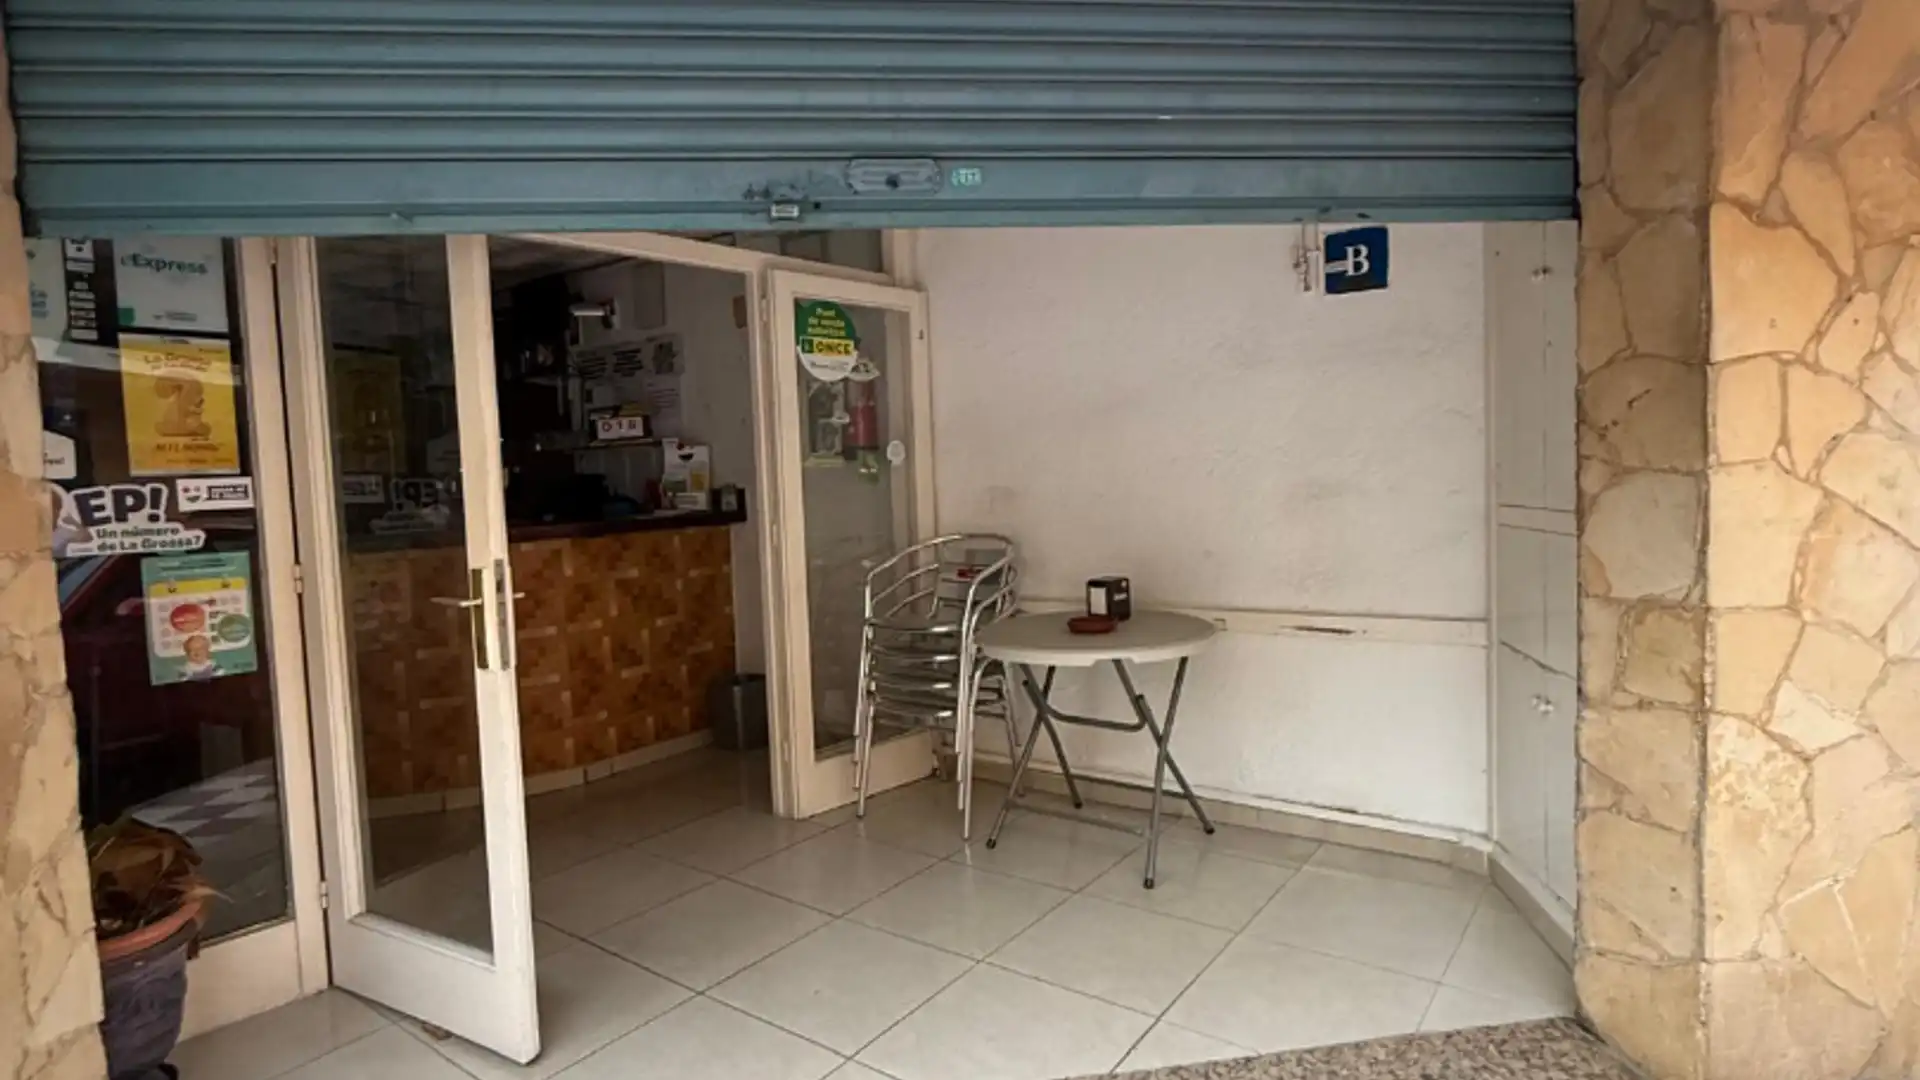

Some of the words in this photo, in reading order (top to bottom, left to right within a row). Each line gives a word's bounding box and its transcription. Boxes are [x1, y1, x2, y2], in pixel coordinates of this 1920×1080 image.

[1344, 244, 1370, 277] B
[816, 340, 852, 356] ONCE
[74, 487, 163, 527] EP!
[96, 528, 117, 540] Un
[121, 525, 180, 538] número
[97, 540, 117, 552] de
[119, 539, 138, 551] La
[141, 535, 202, 550] Grossa?
